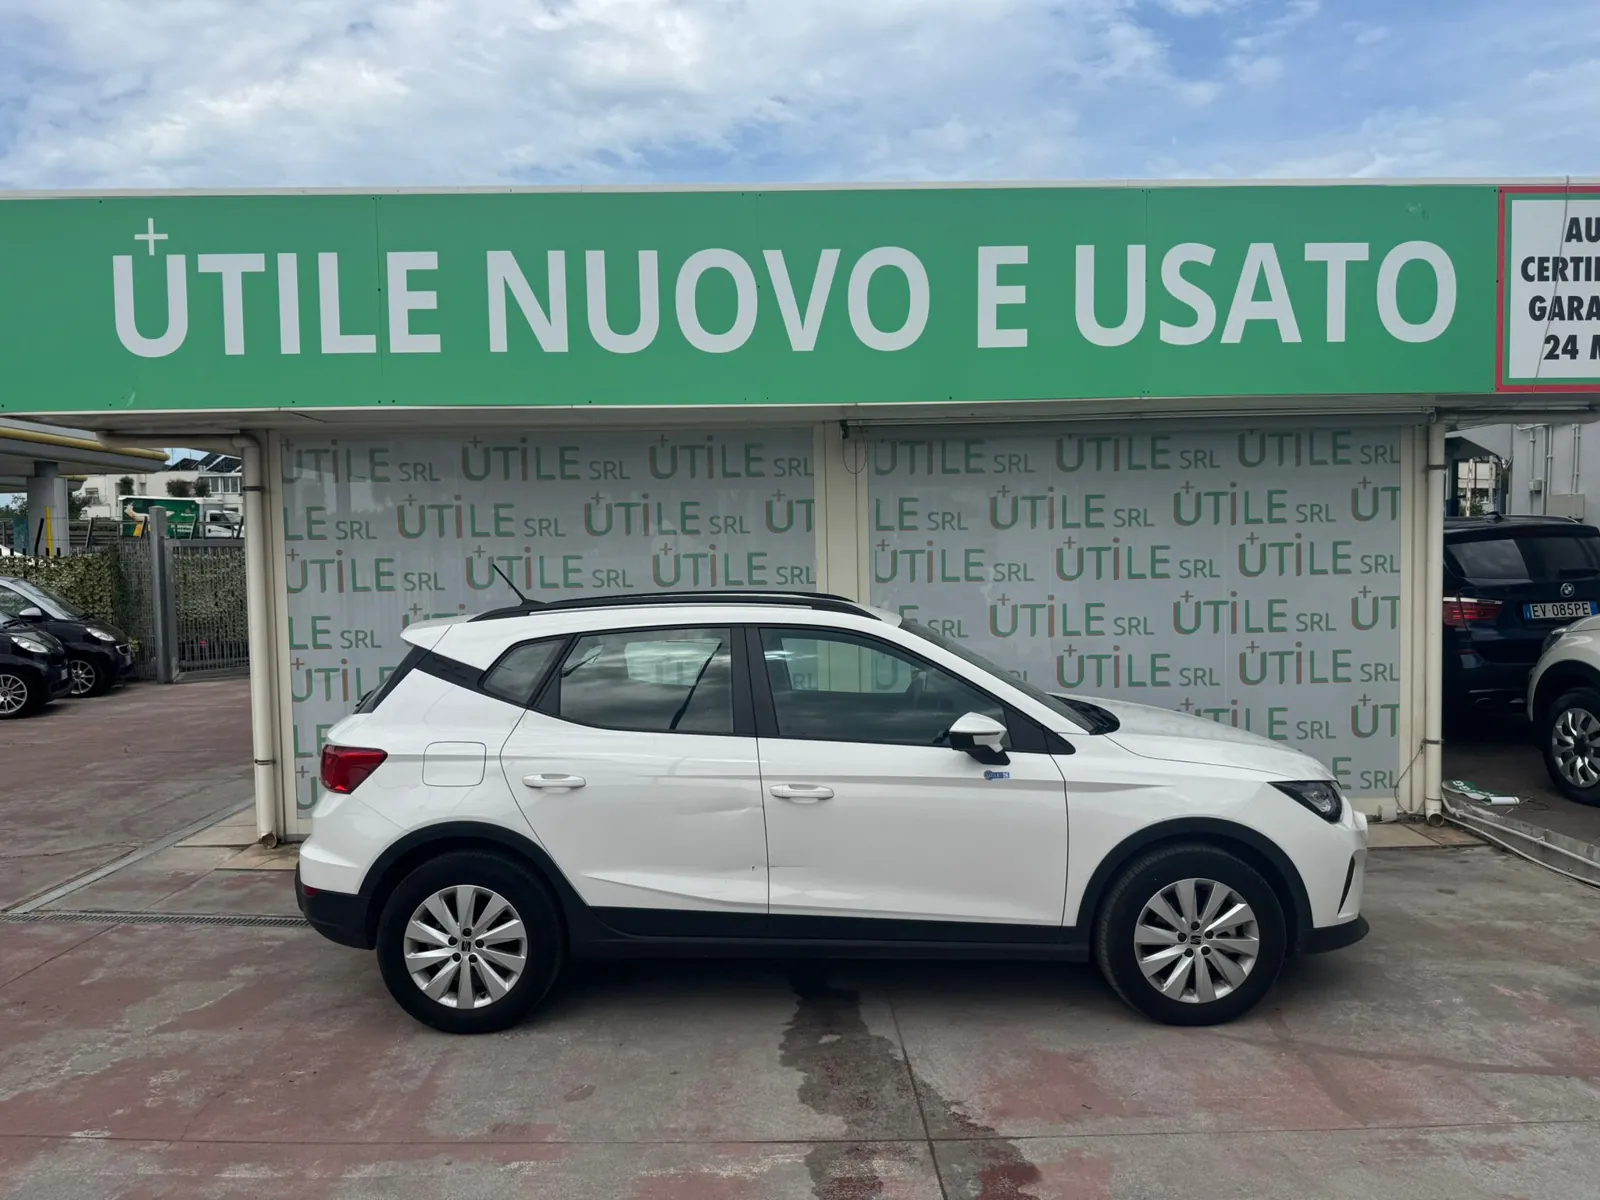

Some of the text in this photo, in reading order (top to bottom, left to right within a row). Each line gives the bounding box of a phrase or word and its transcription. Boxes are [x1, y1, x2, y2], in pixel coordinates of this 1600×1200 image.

[1564, 216, 1600, 242] AU
[112, 240, 1457, 358] UTILE NUOVO E USATO
[1528, 295, 1600, 321] GARA
[1543, 334, 1579, 360] 24
[993, 454, 1035, 473] SRL
[1179, 449, 1221, 469] SRL
[1359, 444, 1400, 464] SRL
[398, 462, 441, 482] SRL
[589, 460, 631, 481] SRL
[774, 458, 814, 477] SRL
[875, 497, 969, 531] LE SRL
[1113, 508, 1155, 527] SRL
[1295, 503, 1337, 523] SRL
[283, 506, 377, 541] LE SRL
[523, 517, 566, 537] SRL
[709, 515, 750, 534] SRL
[993, 562, 1035, 582] SRL
[1179, 559, 1221, 579] SRL
[1360, 554, 1400, 574] SRL
[403, 572, 446, 592] SRL
[592, 569, 634, 588] SRL
[776, 566, 816, 585] SRL
[1113, 617, 1155, 636] SRL
[1295, 612, 1337, 632] SRL
[288, 615, 382, 650] LE SRL
[1179, 667, 1221, 687] SRL
[1359, 663, 1400, 682] SRL
[1295, 720, 1337, 740] SRL
[1359, 771, 1399, 790] SRL
